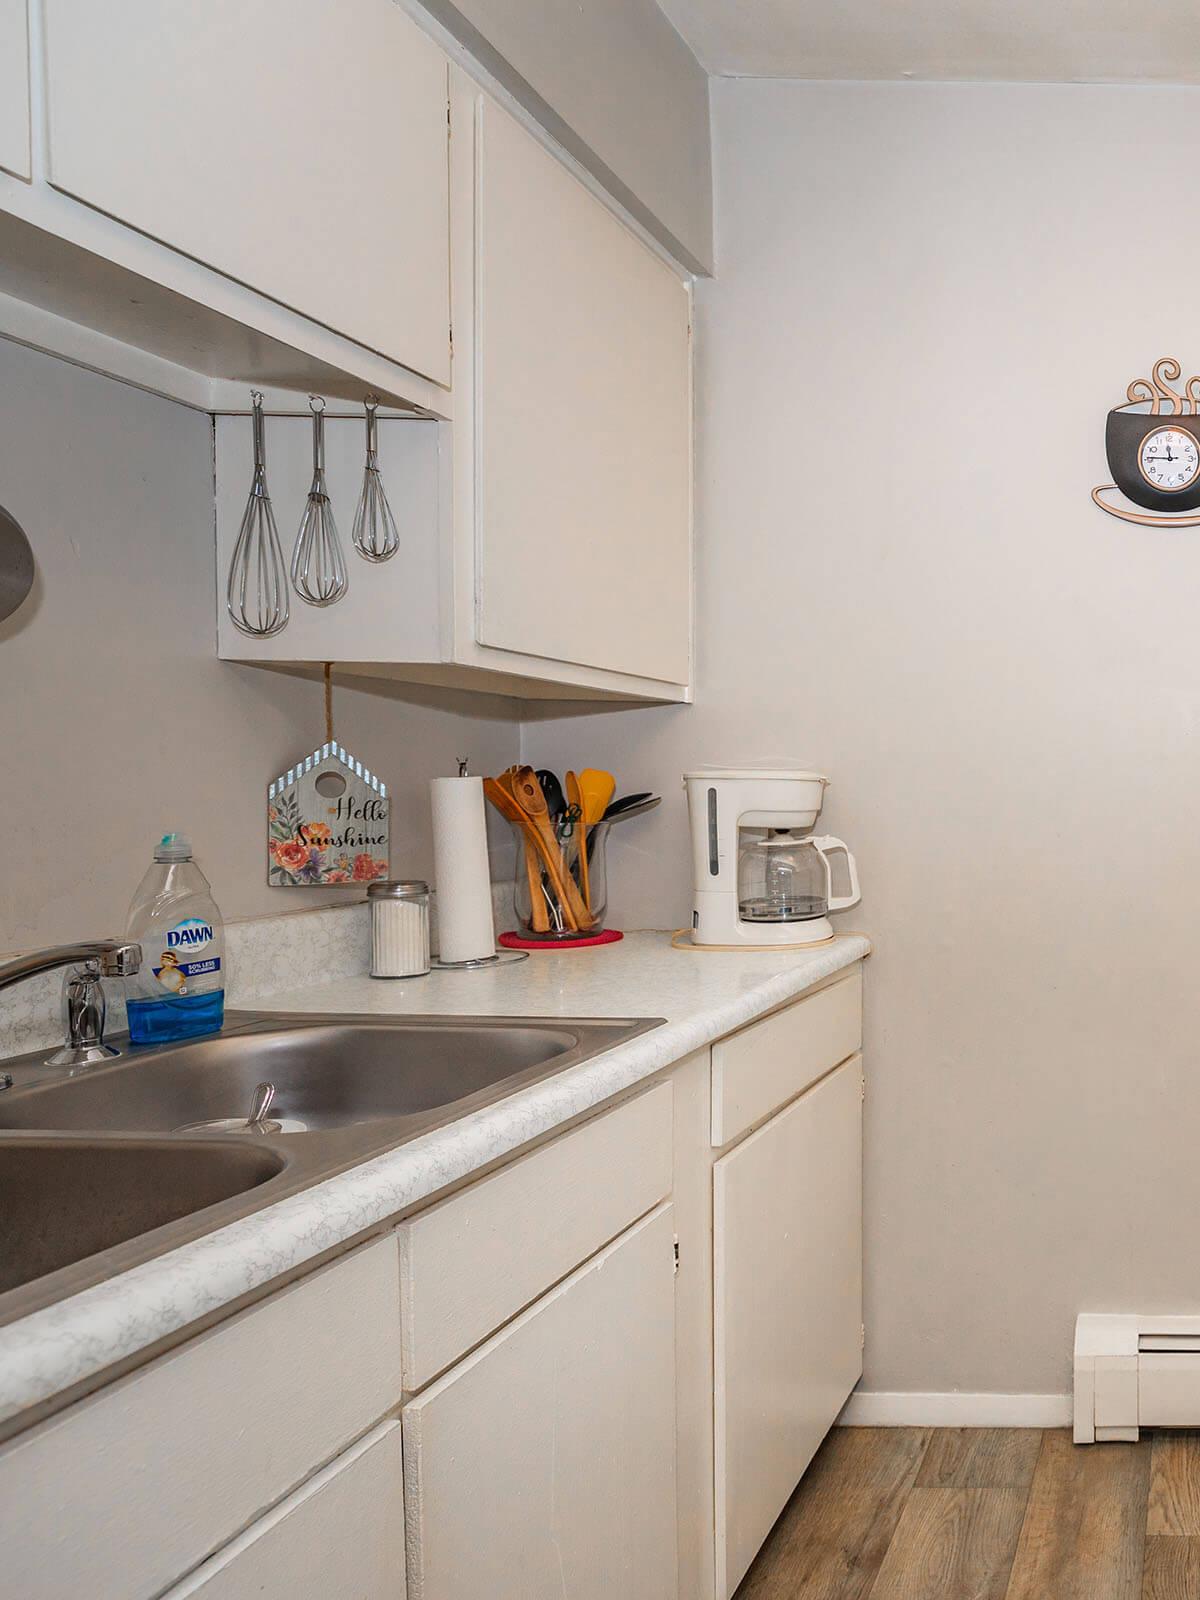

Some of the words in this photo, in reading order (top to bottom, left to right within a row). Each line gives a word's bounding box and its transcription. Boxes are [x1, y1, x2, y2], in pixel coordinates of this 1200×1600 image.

[335, 796, 387, 821] Hello
[296, 822, 388, 848] Sunshine
[167, 926, 213, 947] DAWN
